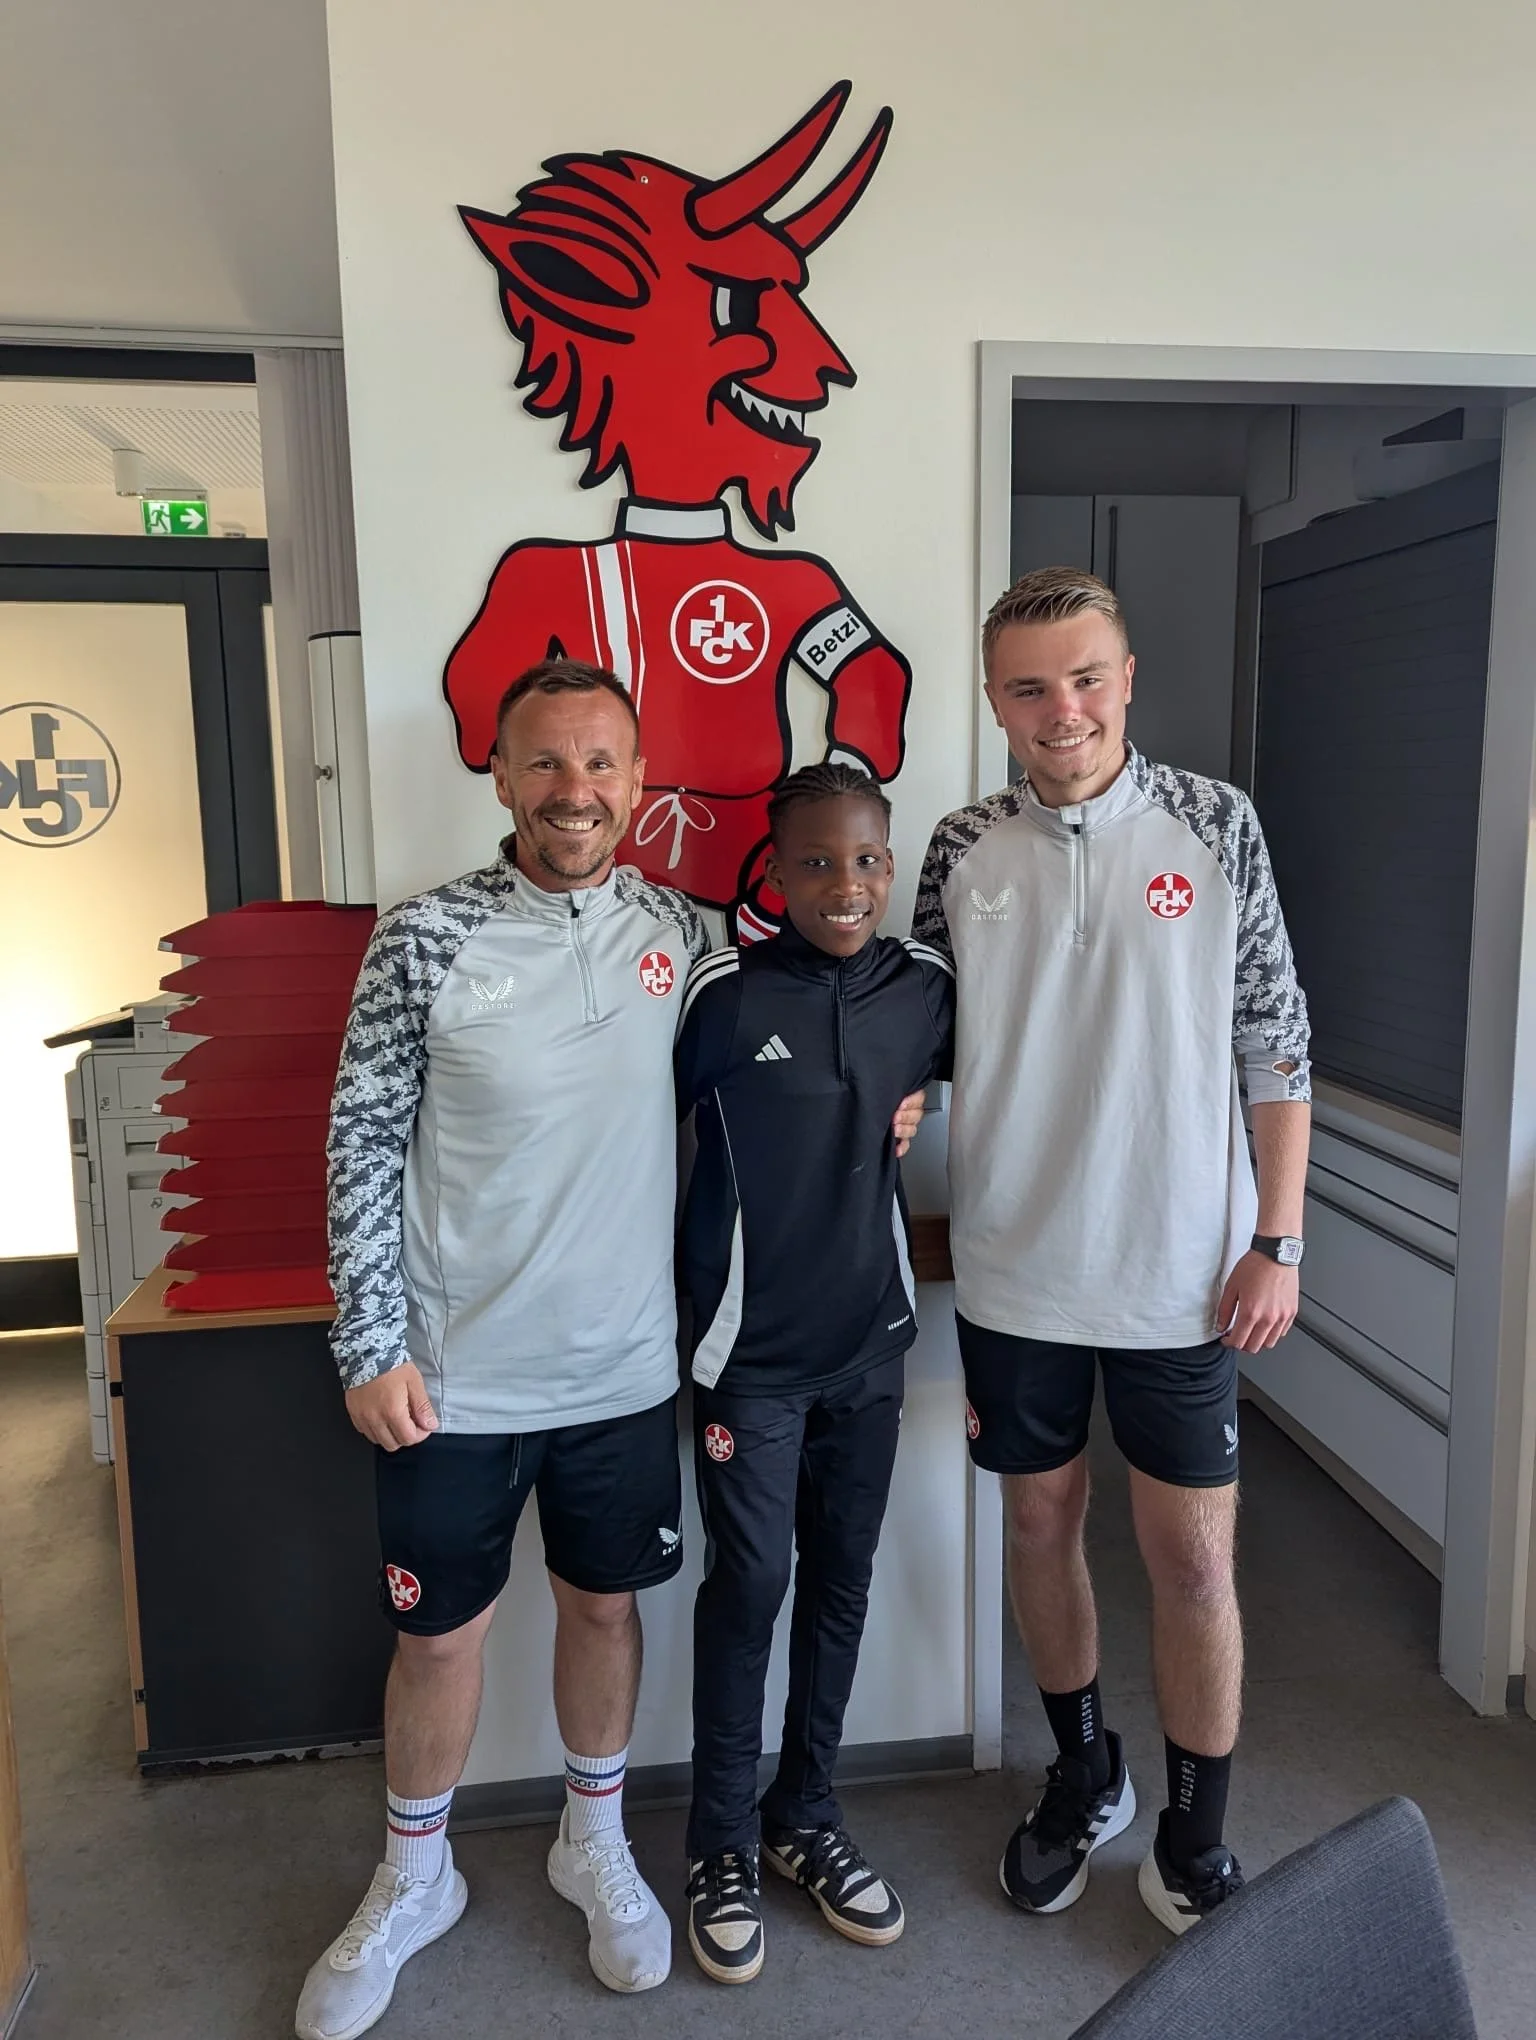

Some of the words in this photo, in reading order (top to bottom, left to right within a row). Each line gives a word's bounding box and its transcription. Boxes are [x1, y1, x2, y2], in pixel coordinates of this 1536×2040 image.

[806, 613, 861, 666] Betzi
[1081, 1694, 1095, 1744] CASTORE
[1179, 1760, 1196, 1812] CASTORE
